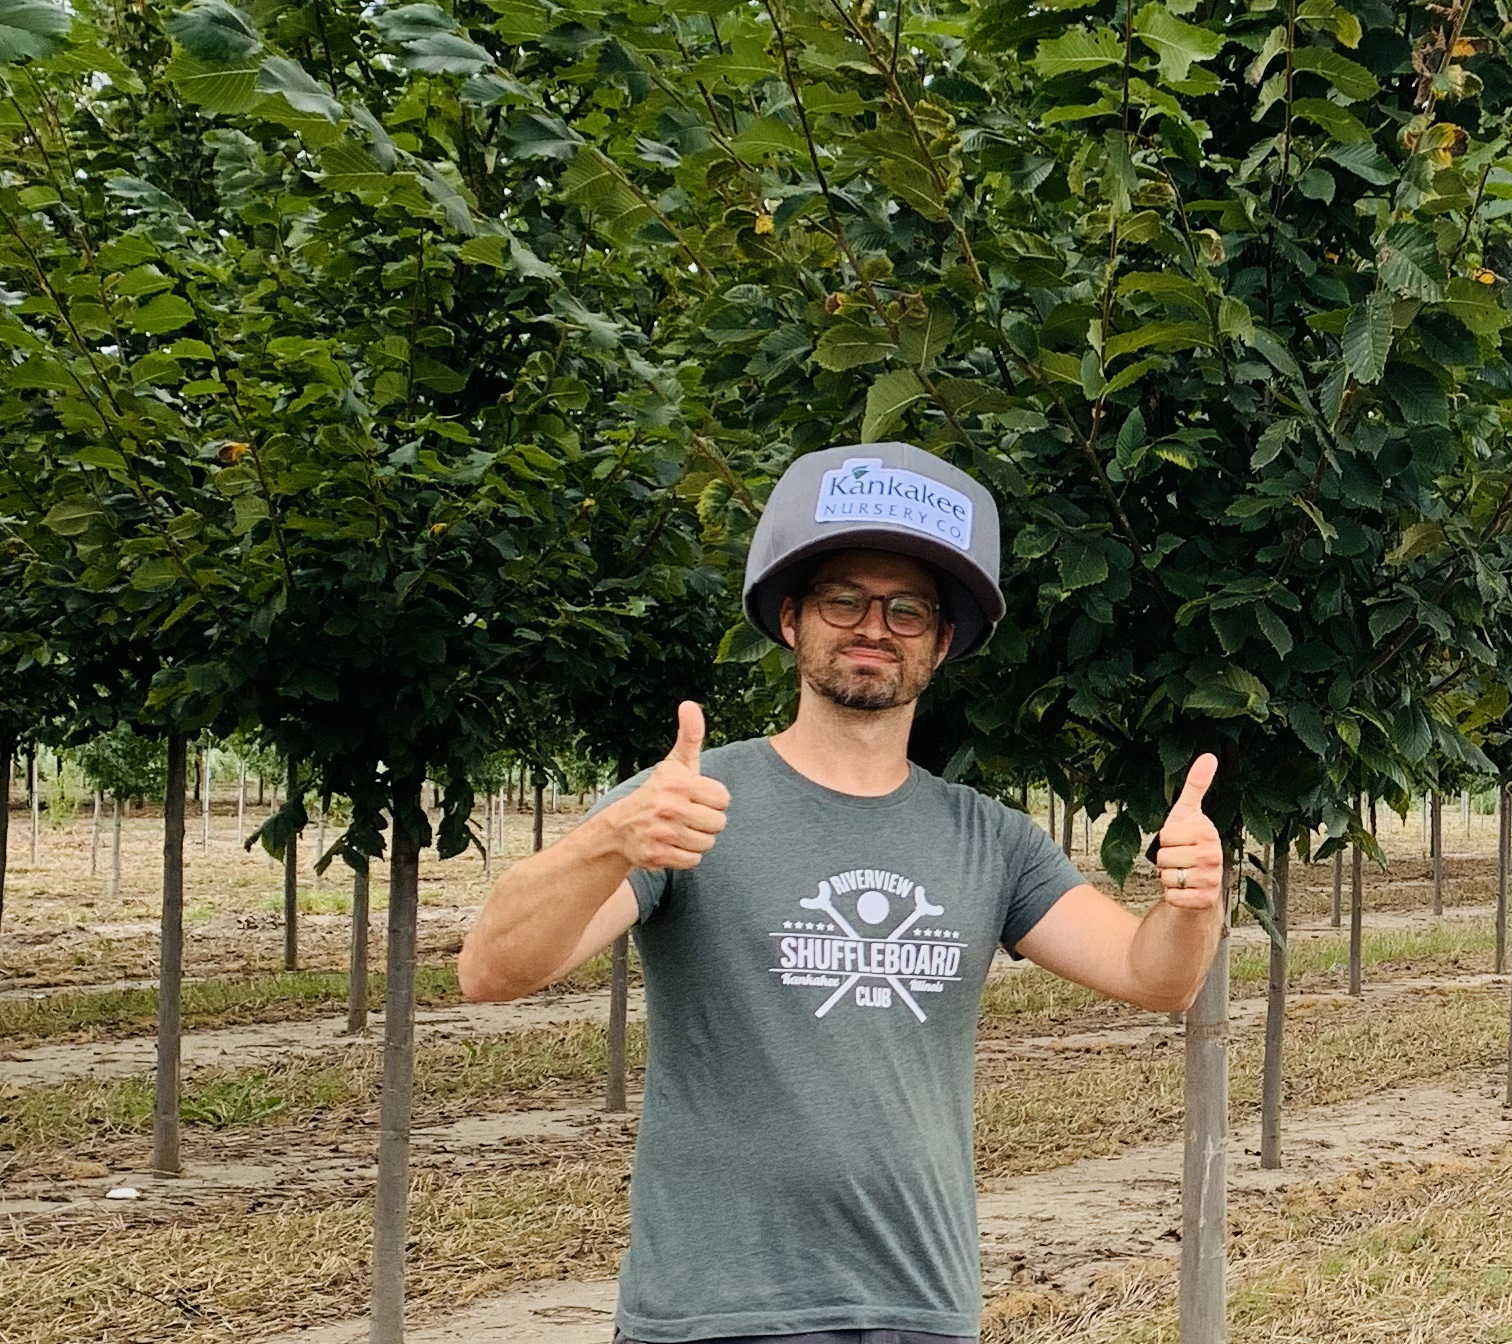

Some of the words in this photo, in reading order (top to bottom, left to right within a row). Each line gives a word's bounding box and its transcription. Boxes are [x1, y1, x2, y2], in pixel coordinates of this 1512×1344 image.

[829, 476, 966, 522] Kankakee
[823, 502, 928, 524] NURSERY
[936, 519, 964, 542] CO.
[829, 869, 914, 899] RIVERVIEW
[780, 937, 961, 976] SHUFFLEBOARD
[855, 985, 892, 1009] CLUB
